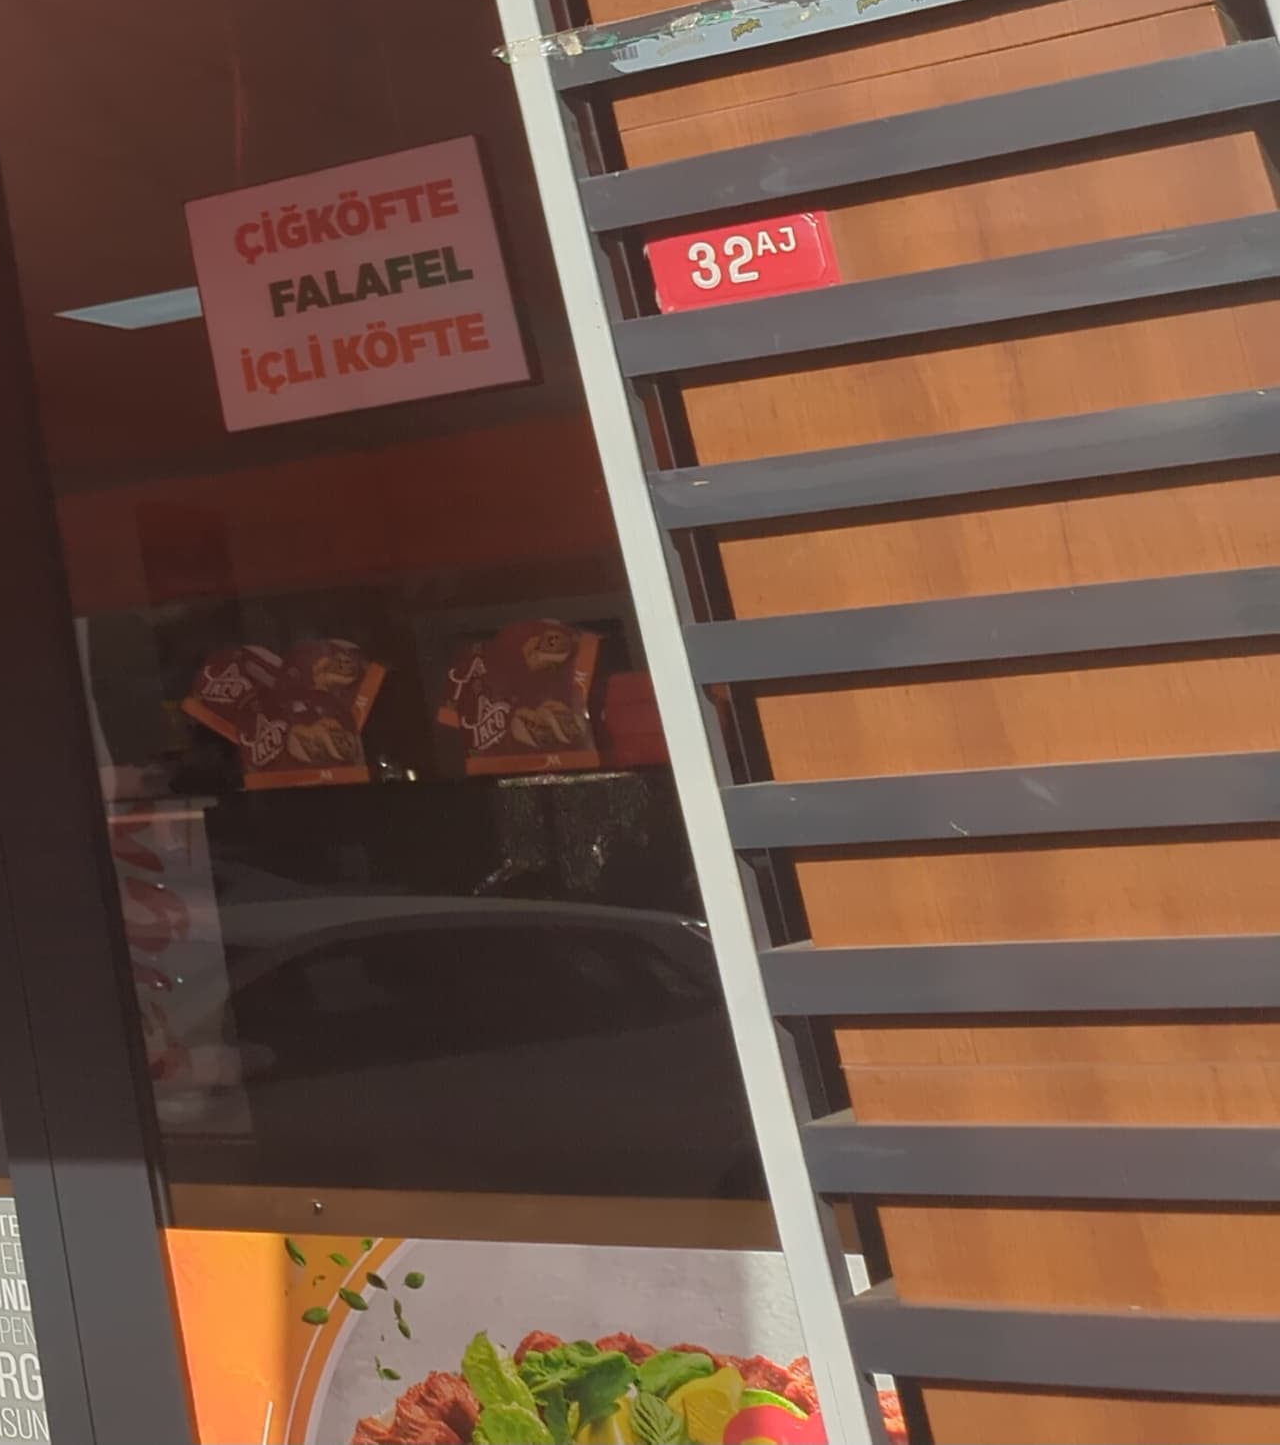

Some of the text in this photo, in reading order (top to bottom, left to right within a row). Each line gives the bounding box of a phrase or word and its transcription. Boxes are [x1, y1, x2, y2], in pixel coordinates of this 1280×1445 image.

[234, 177, 460, 266] ÇİĞKÖFTE
[268, 245, 475, 318] FALAFEL
[240, 312, 490, 395] İÇLİ KÖFTE
